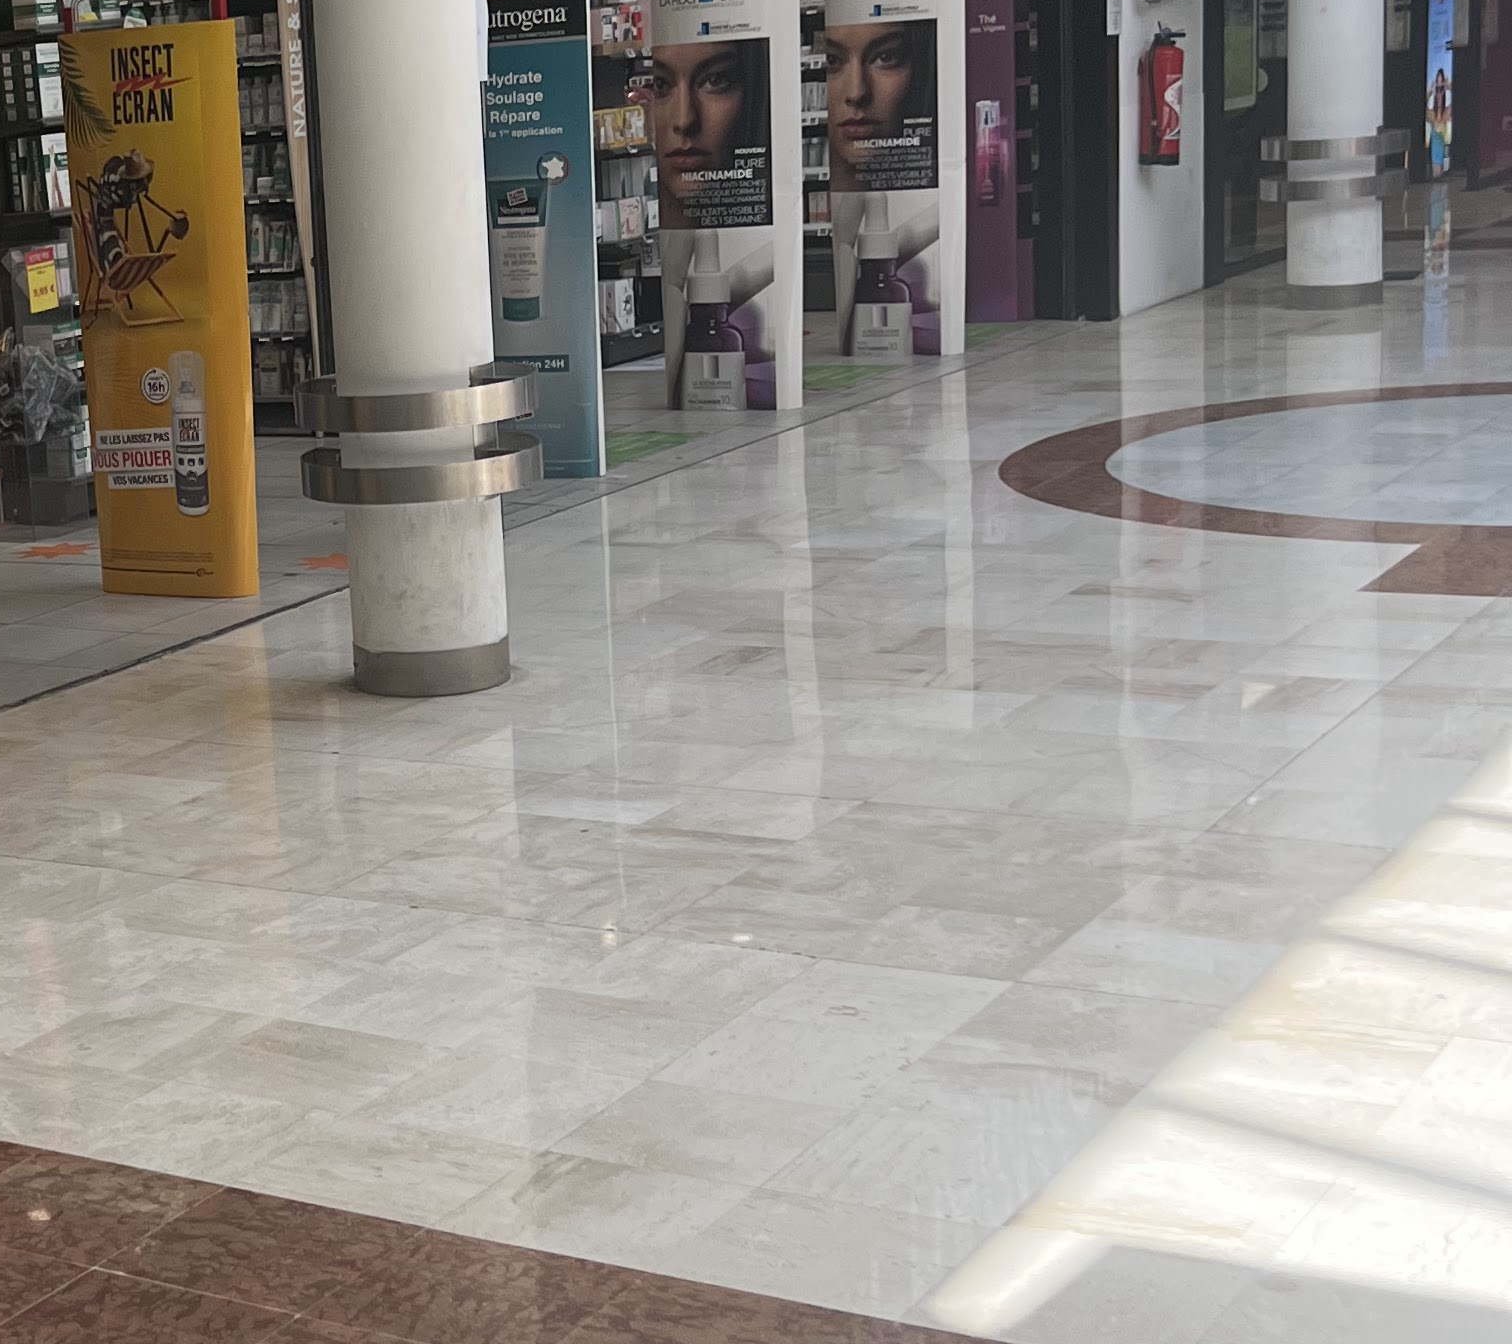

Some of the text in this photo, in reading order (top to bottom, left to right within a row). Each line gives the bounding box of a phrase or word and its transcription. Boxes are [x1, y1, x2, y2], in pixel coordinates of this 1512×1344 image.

[287, 11, 301, 31] &
[488, 5, 567, 32] utrogena
[111, 43, 174, 82] INSECT
[486, 71, 542, 88] Hydrate
[288, 38, 307, 139] NATURE
[486, 90, 543, 106] Soulage
[112, 87, 174, 126] ECRAN
[490, 110, 541, 126] Répare
[903, 126, 932, 138] PURE
[734, 157, 766, 169] PURE
[681, 168, 754, 182] NIACINAMIDE
[544, 359, 565, 369] 24H
[147, 381, 166, 393] 16h
[153, 432, 170, 443] PAS
[122, 449, 172, 468] PIQUER
[128, 474, 169, 485] VACANCES
